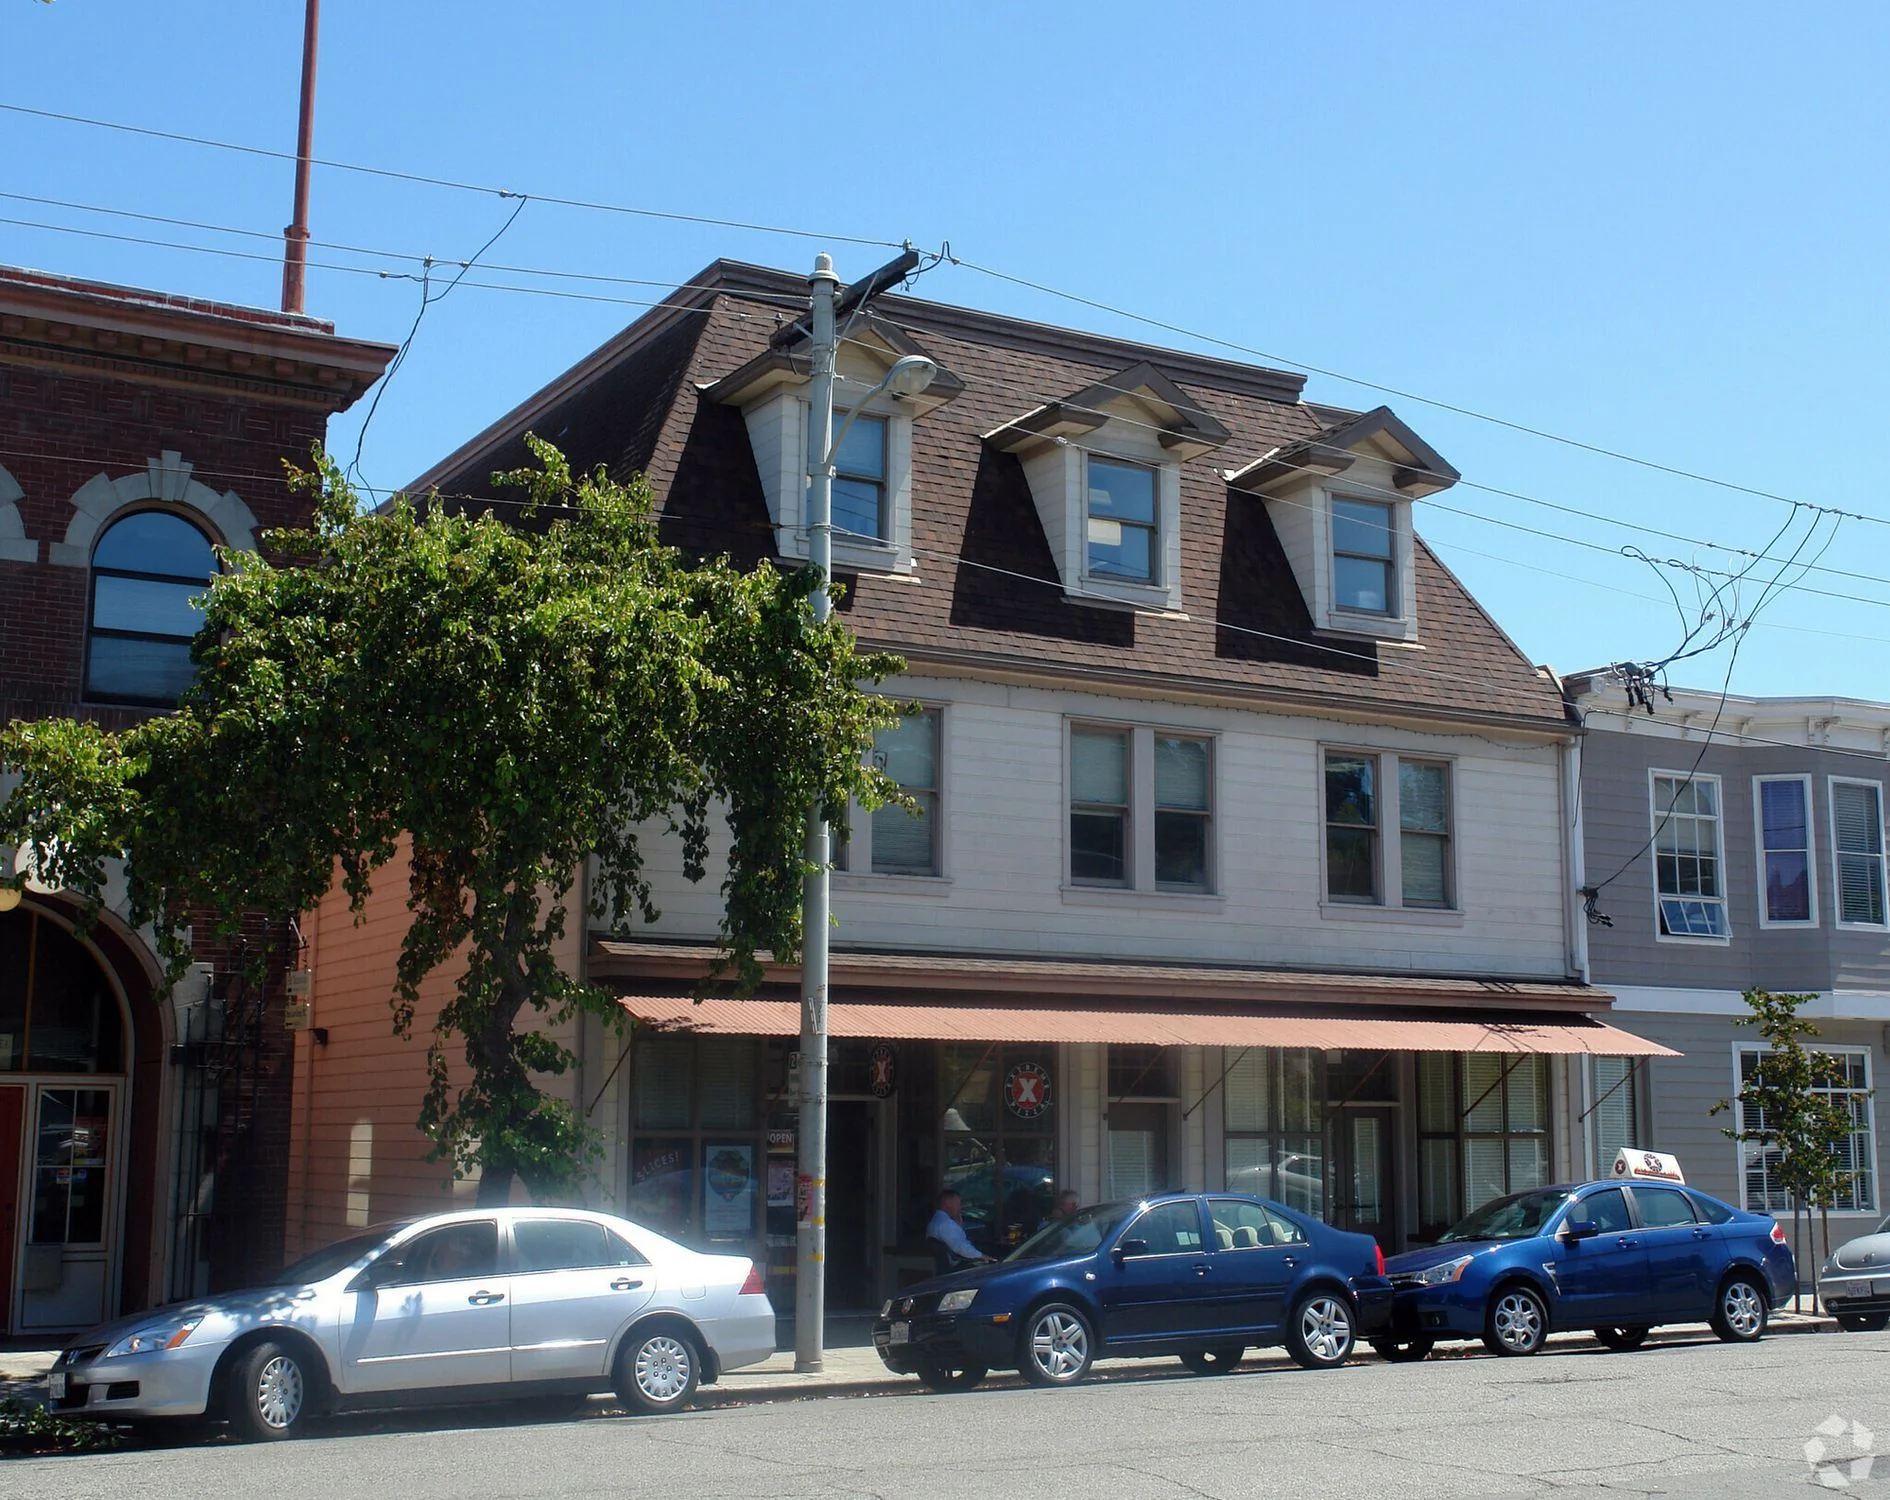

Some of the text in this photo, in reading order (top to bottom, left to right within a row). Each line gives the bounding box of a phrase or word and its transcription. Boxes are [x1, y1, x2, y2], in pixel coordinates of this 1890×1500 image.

[1018, 1078, 1039, 1103] X
[769, 1132, 793, 1145] OPEN
[636, 1151, 680, 1181] SLICES!
